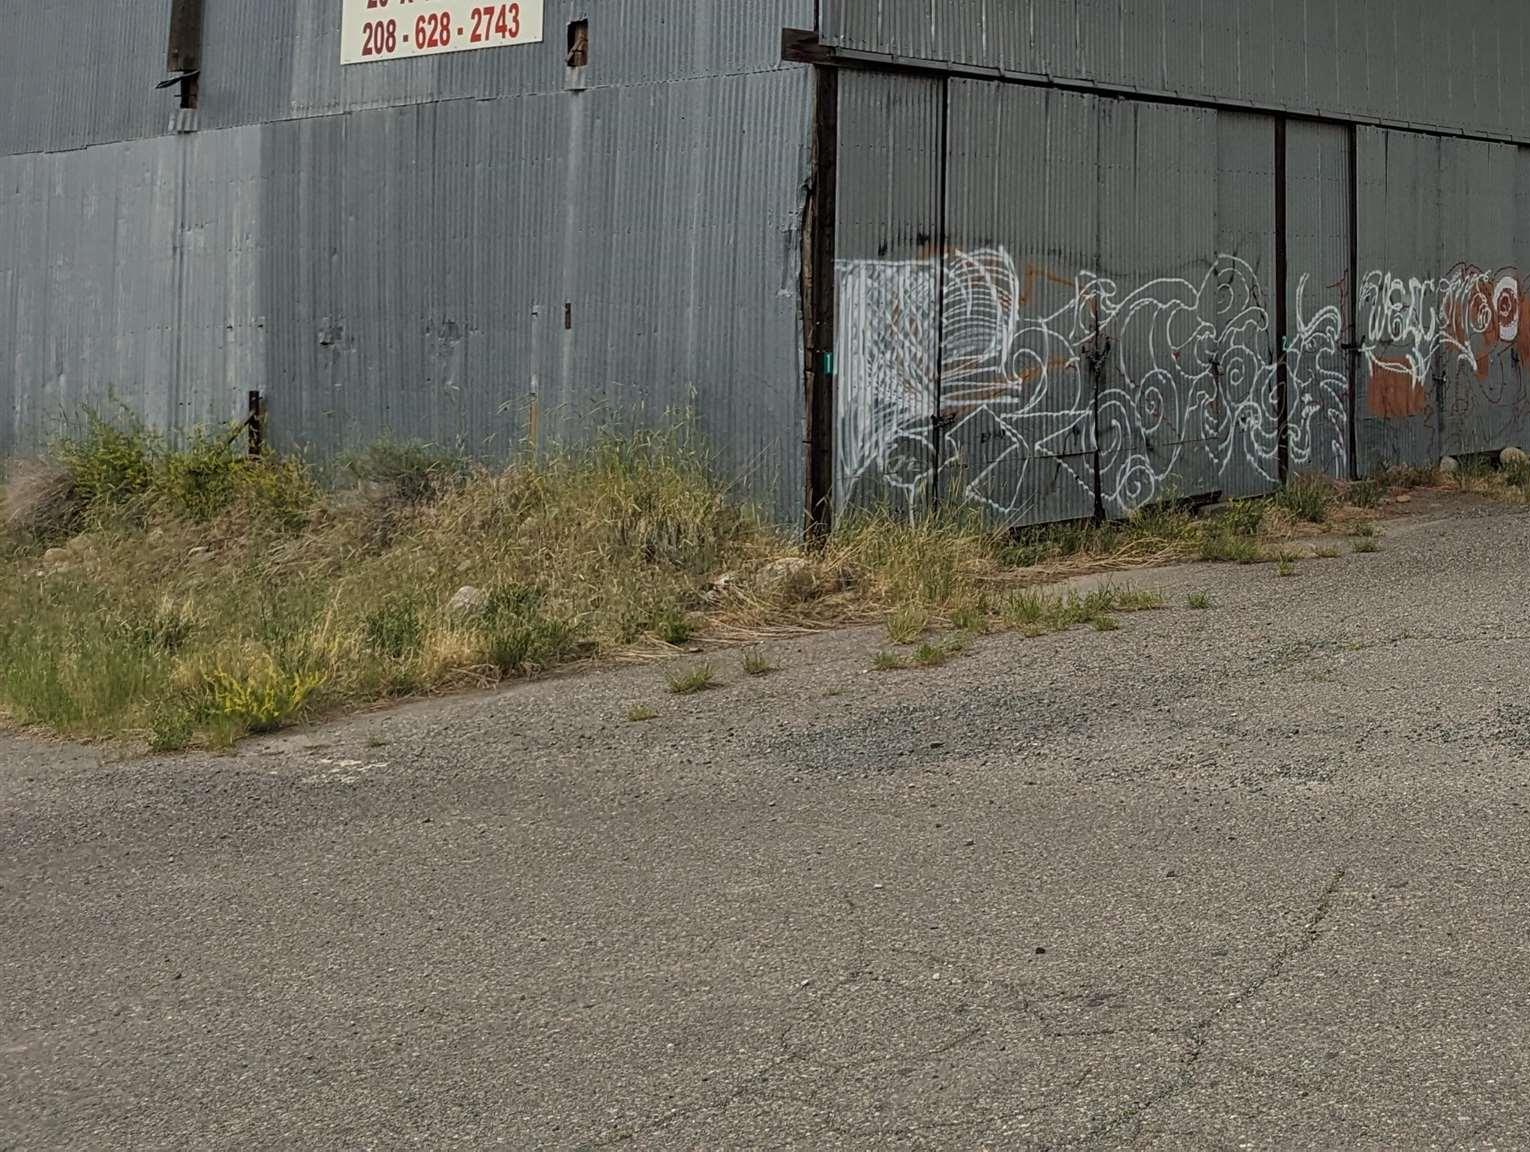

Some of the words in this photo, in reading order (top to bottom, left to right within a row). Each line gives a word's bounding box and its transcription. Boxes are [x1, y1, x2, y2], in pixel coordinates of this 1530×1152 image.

[361, 18, 397, 56] 208
[415, 11, 451, 49] 628
[470, 2, 520, 43] 2743
